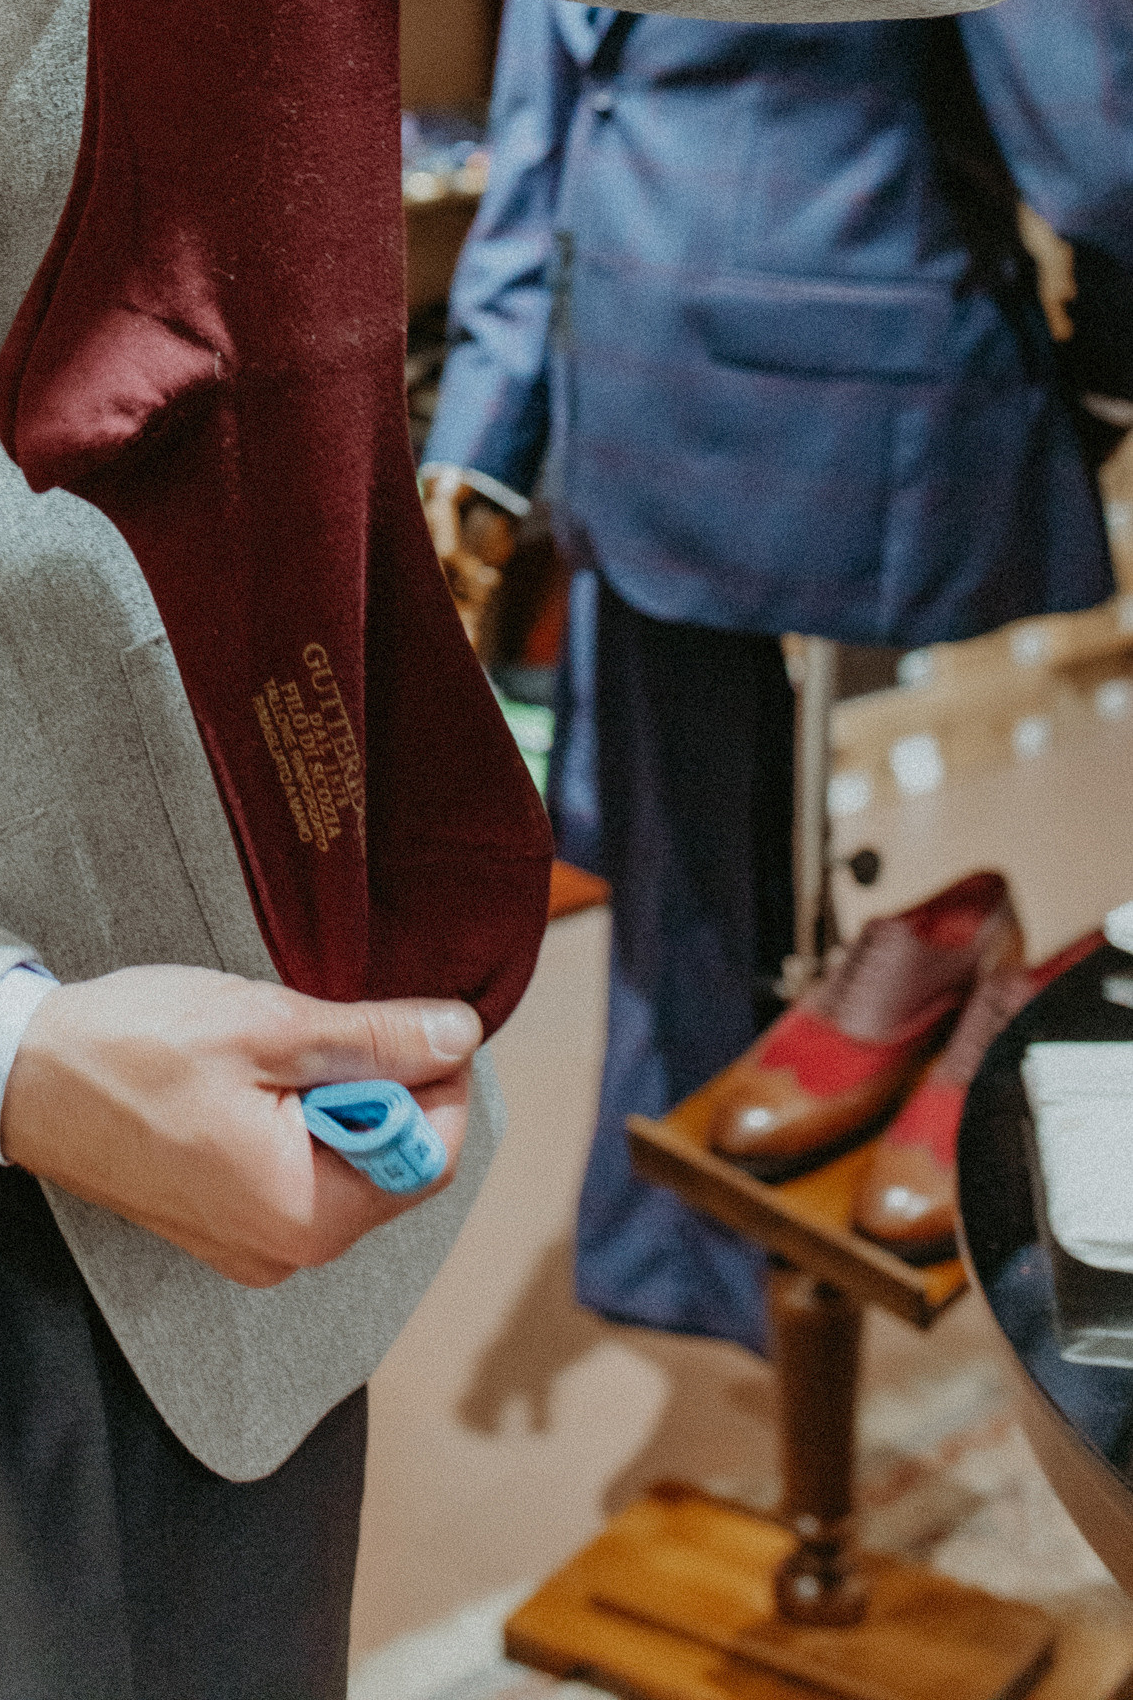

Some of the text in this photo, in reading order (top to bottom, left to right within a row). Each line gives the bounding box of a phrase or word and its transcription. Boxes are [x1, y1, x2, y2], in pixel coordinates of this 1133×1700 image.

[280, 681, 343, 840] FILO DI SCOZIA
[308, 712, 333, 756] DAL
